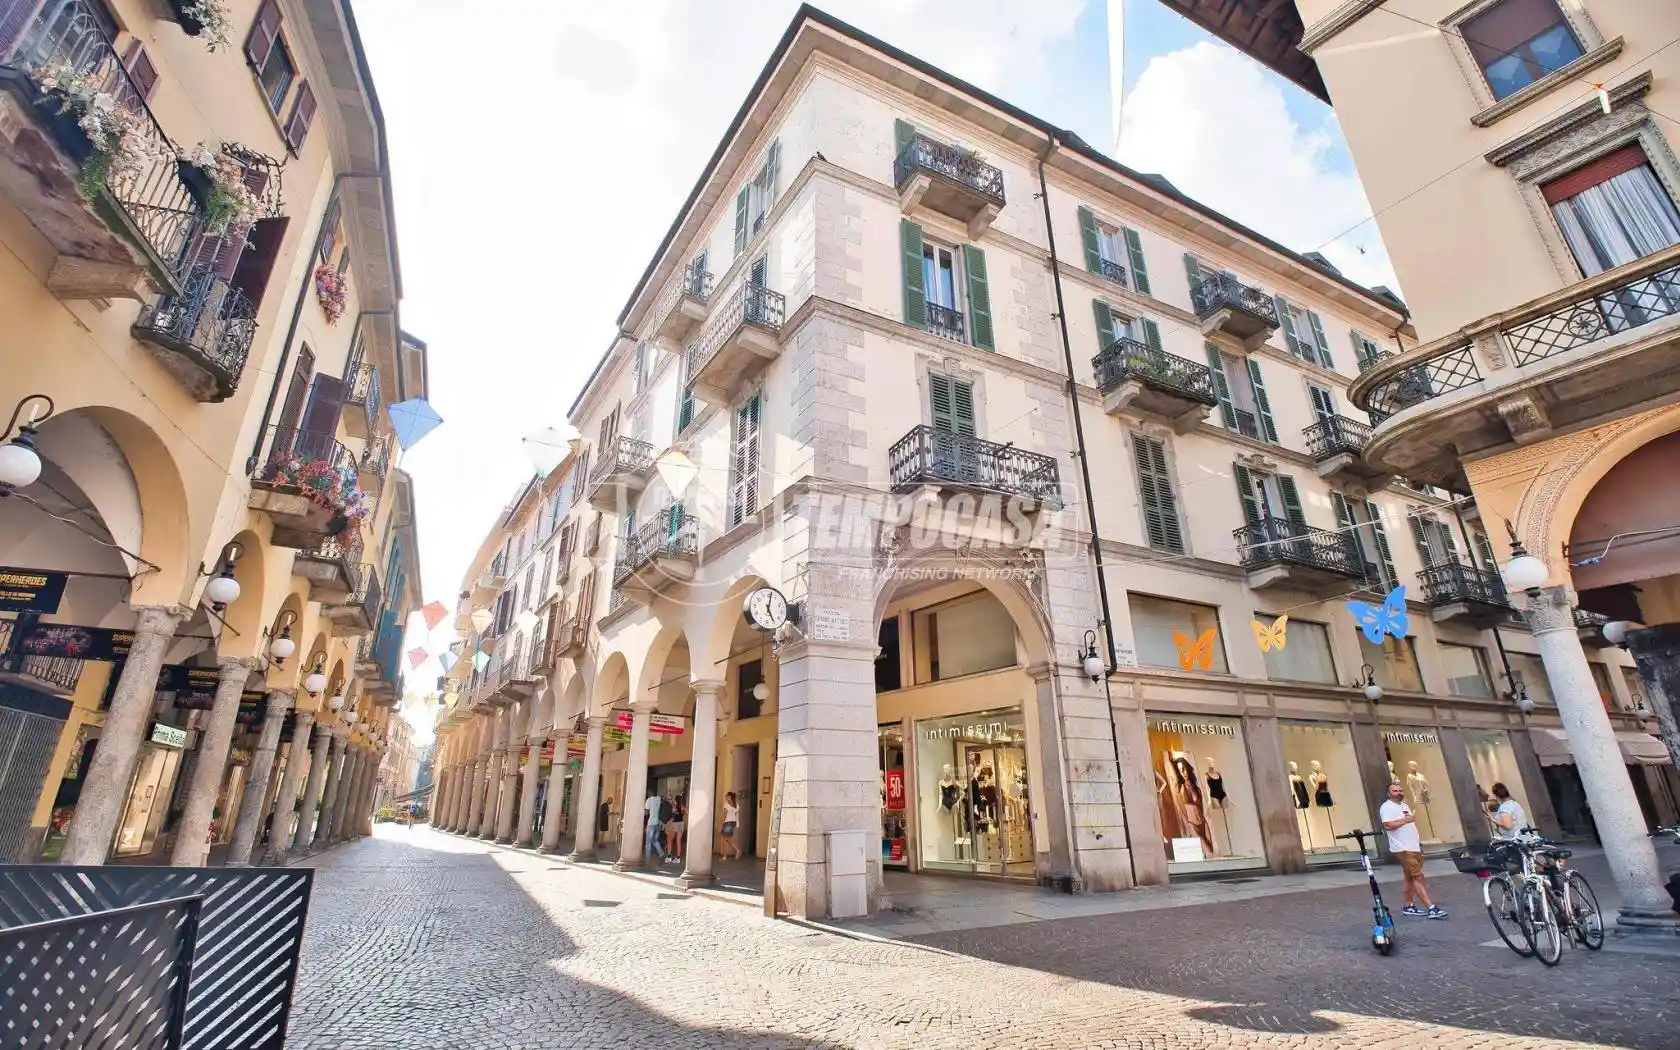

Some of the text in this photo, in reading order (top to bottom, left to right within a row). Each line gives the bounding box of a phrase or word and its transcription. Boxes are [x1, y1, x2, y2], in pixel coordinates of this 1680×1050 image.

[926, 721, 1008, 740] intimissimi
[1156, 721, 1236, 737] intimissimi
[1386, 732, 1438, 745] intimissimi
